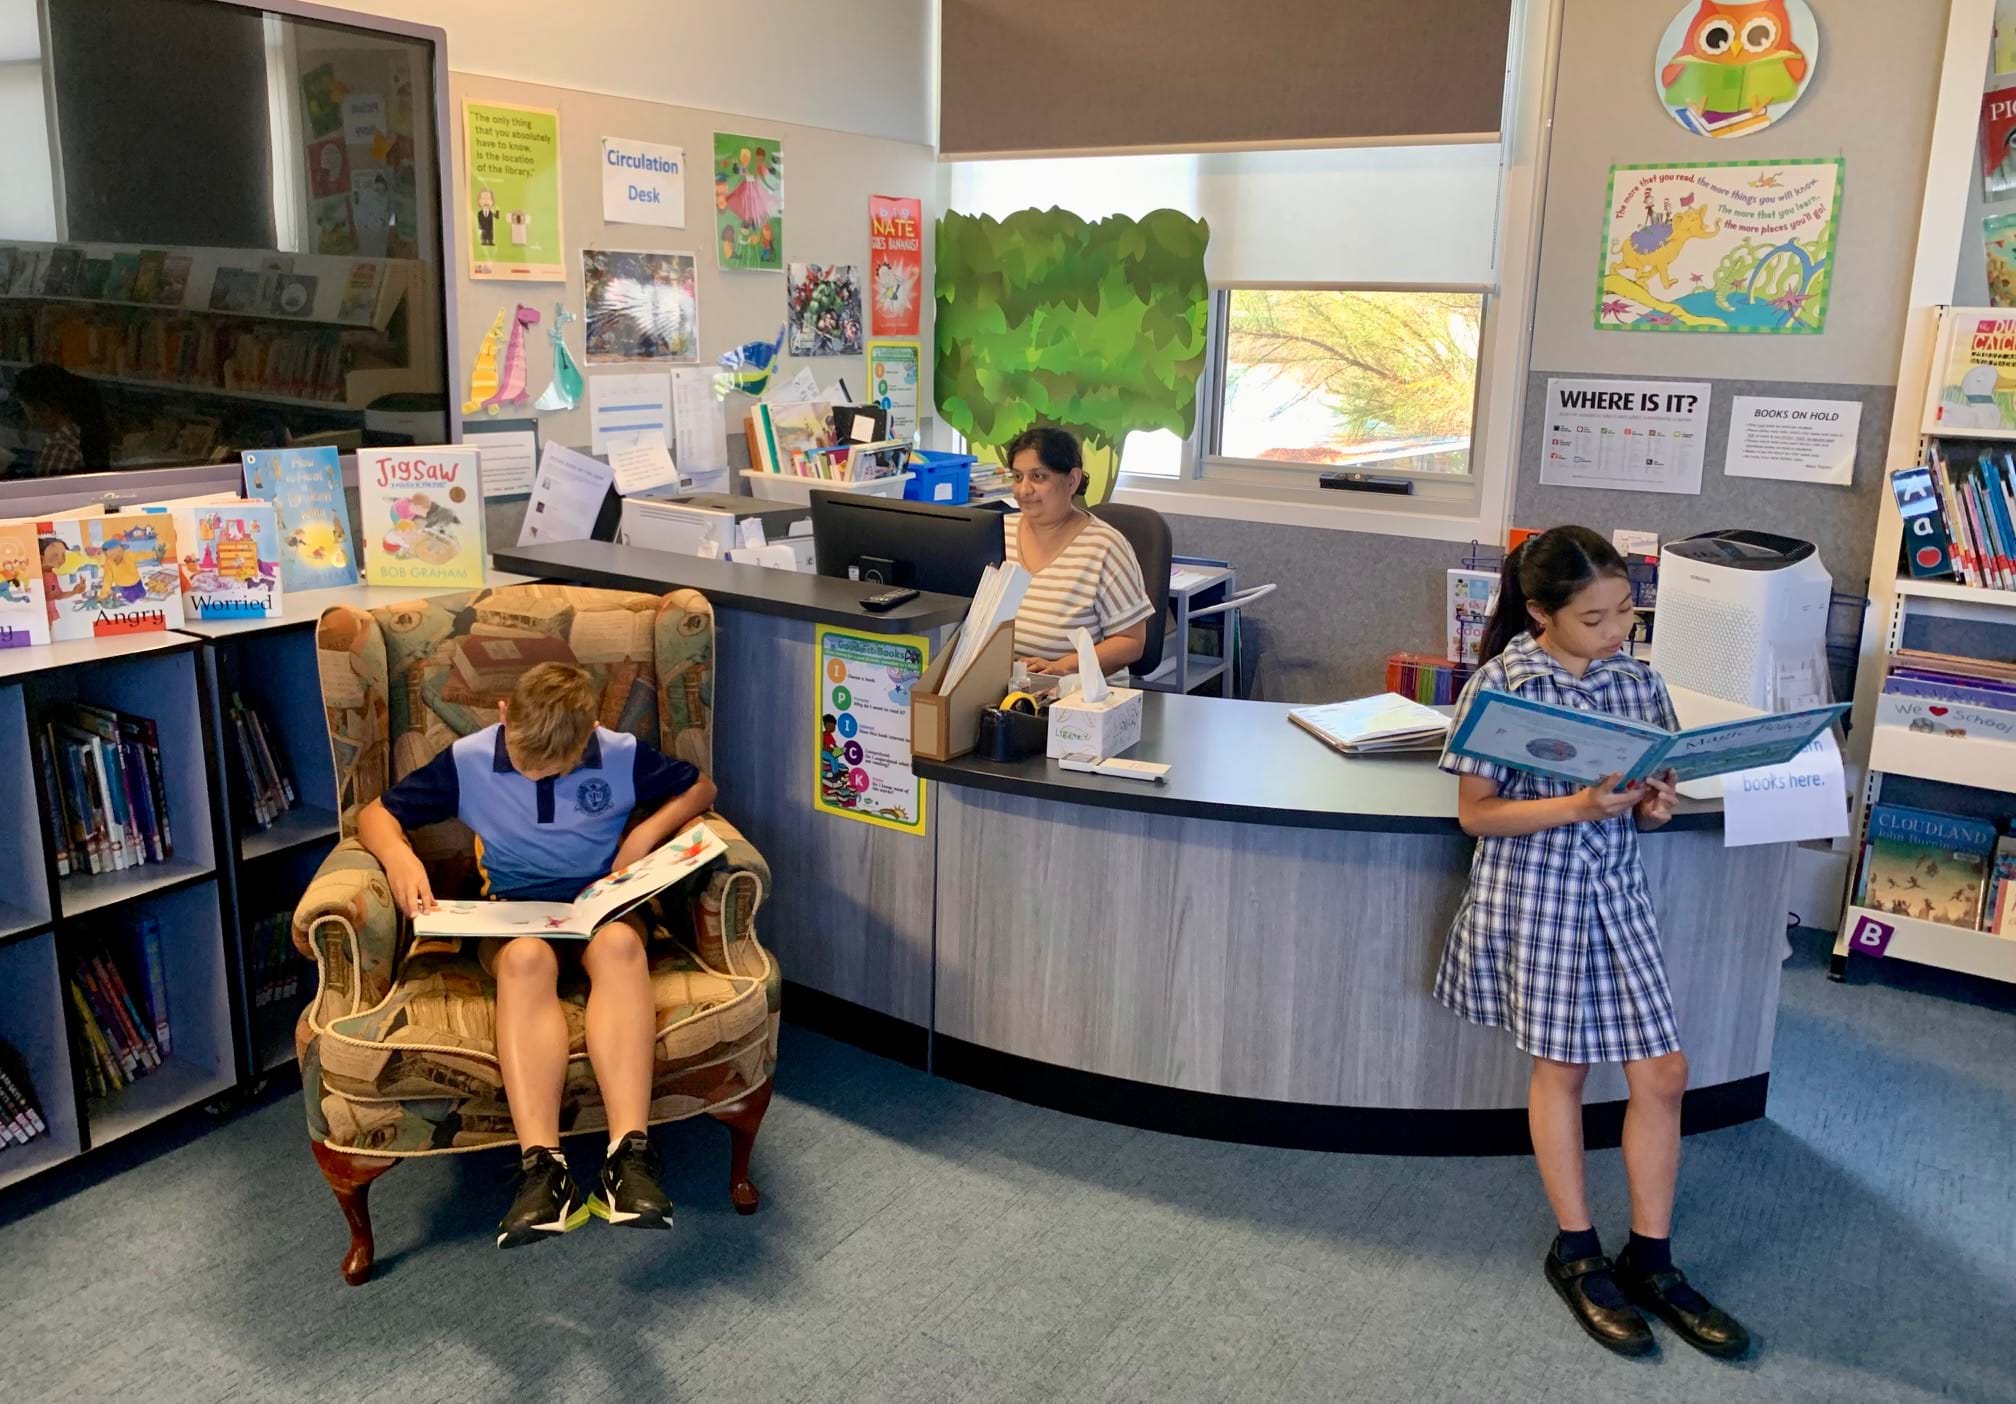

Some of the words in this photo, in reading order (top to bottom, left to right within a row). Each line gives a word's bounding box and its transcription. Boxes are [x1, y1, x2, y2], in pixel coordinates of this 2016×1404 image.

[492, 116, 510, 128] only
[512, 118, 532, 130] thing
[475, 126, 493, 136] that
[495, 129, 510, 138] you
[512, 130, 552, 144] absolutely
[476, 138, 496, 148] have
[498, 141, 507, 150] to
[486, 152, 500, 162] the
[502, 153, 535, 165] location
[608, 149, 678, 174] Circulation
[476, 164, 486, 172] of
[488, 164, 502, 174] the
[628, 185, 660, 204] Desk
[1624, 186, 1640, 204] more
[1640, 174, 1656, 186] that
[1659, 174, 1674, 184] you
[1696, 177, 1710, 188] the
[1710, 184, 1730, 196] more
[1731, 190, 1757, 206] things
[1760, 196, 1776, 206] you
[1778, 192, 1794, 202] will
[1718, 204, 1732, 214] The
[1734, 209, 1755, 219] more
[1756, 210, 1776, 220] that
[1778, 207, 1795, 219] you
[1724, 220, 1738, 230] the
[1738, 224, 1759, 232] more
[1760, 224, 1788, 236] places
[1813, 202, 1826, 220] go!
[873, 216, 916, 238] NATE
[1560, 390, 1635, 412] WHERE
[1640, 393, 1660, 412] IS
[1666, 394, 1698, 414] IT?
[1754, 408, 1789, 419] BOOKS
[1792, 410, 1808, 420] ON
[1810, 412, 1840, 422] HOLD
[1904, 474, 1927, 501] A
[1914, 517, 1934, 536] a
[380, 566, 407, 578] BOB
[410, 567, 468, 580] GRAHAM
[190, 594, 272, 612] Worried
[95, 608, 164, 628] Angry
[878, 648, 904, 659] Books
[838, 692, 846, 704] P
[844, 720, 850, 732] I
[1895, 704, 1922, 714] We
[1953, 710, 2014, 734] School
[849, 746, 857, 759] C
[855, 774, 863, 787] K
[1744, 772, 1786, 792] books
[1788, 772, 1825, 789] here.
[1878, 814, 1988, 844] CLOUDLAND
[1879, 828, 1904, 841] John
[1859, 922, 1882, 946] B
